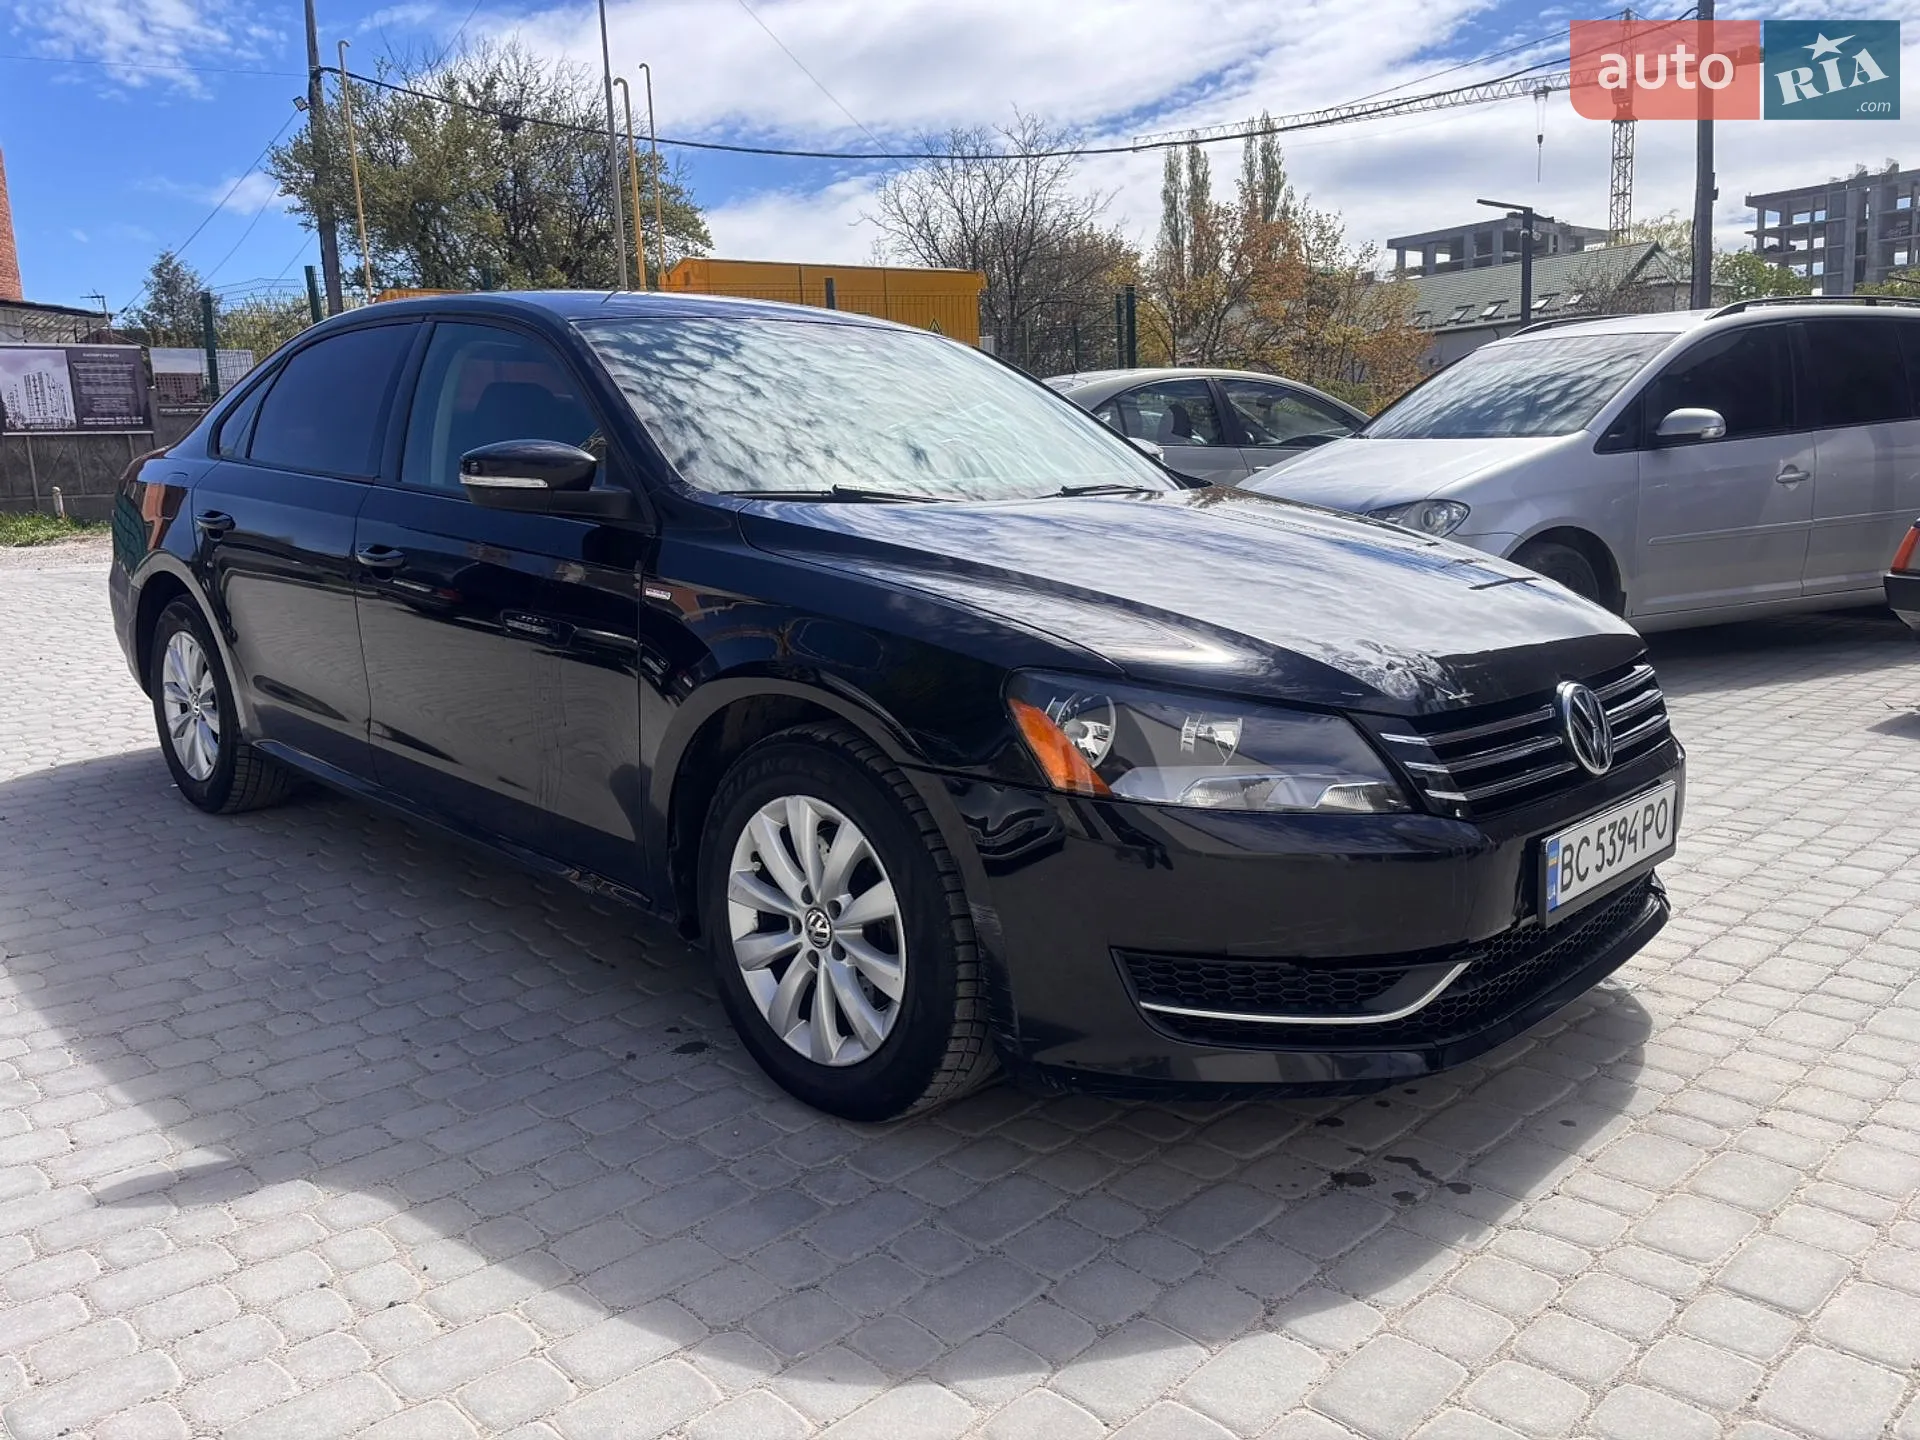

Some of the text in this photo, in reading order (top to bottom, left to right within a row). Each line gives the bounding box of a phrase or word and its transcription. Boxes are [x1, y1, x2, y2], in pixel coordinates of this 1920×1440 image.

[1560, 797, 1668, 893] BC 5394 PO
